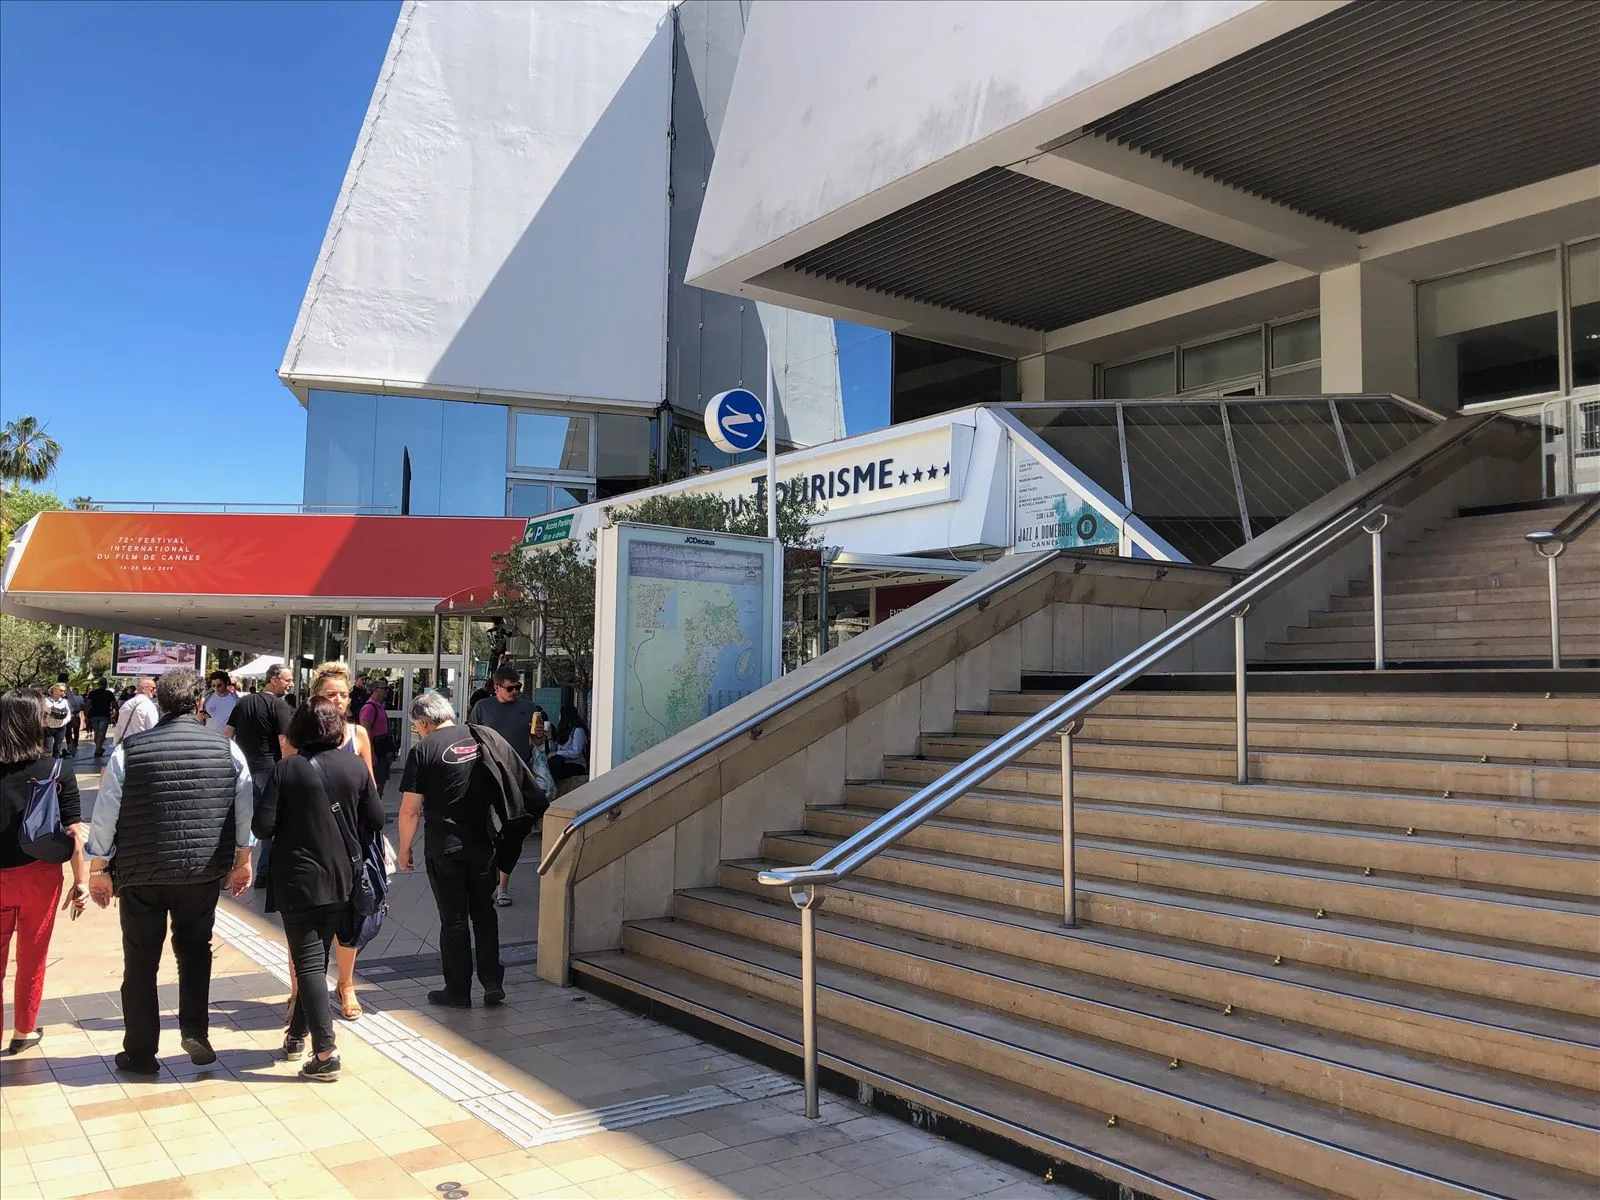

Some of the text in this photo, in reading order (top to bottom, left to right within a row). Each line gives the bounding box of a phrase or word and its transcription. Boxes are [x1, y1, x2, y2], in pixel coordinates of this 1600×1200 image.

[534, 526, 542, 542] P
[1018, 526, 1032, 542] JAZZ
[1042, 522, 1072, 539] DOMERGUE
[684, 536, 716, 546] JCDecaux
